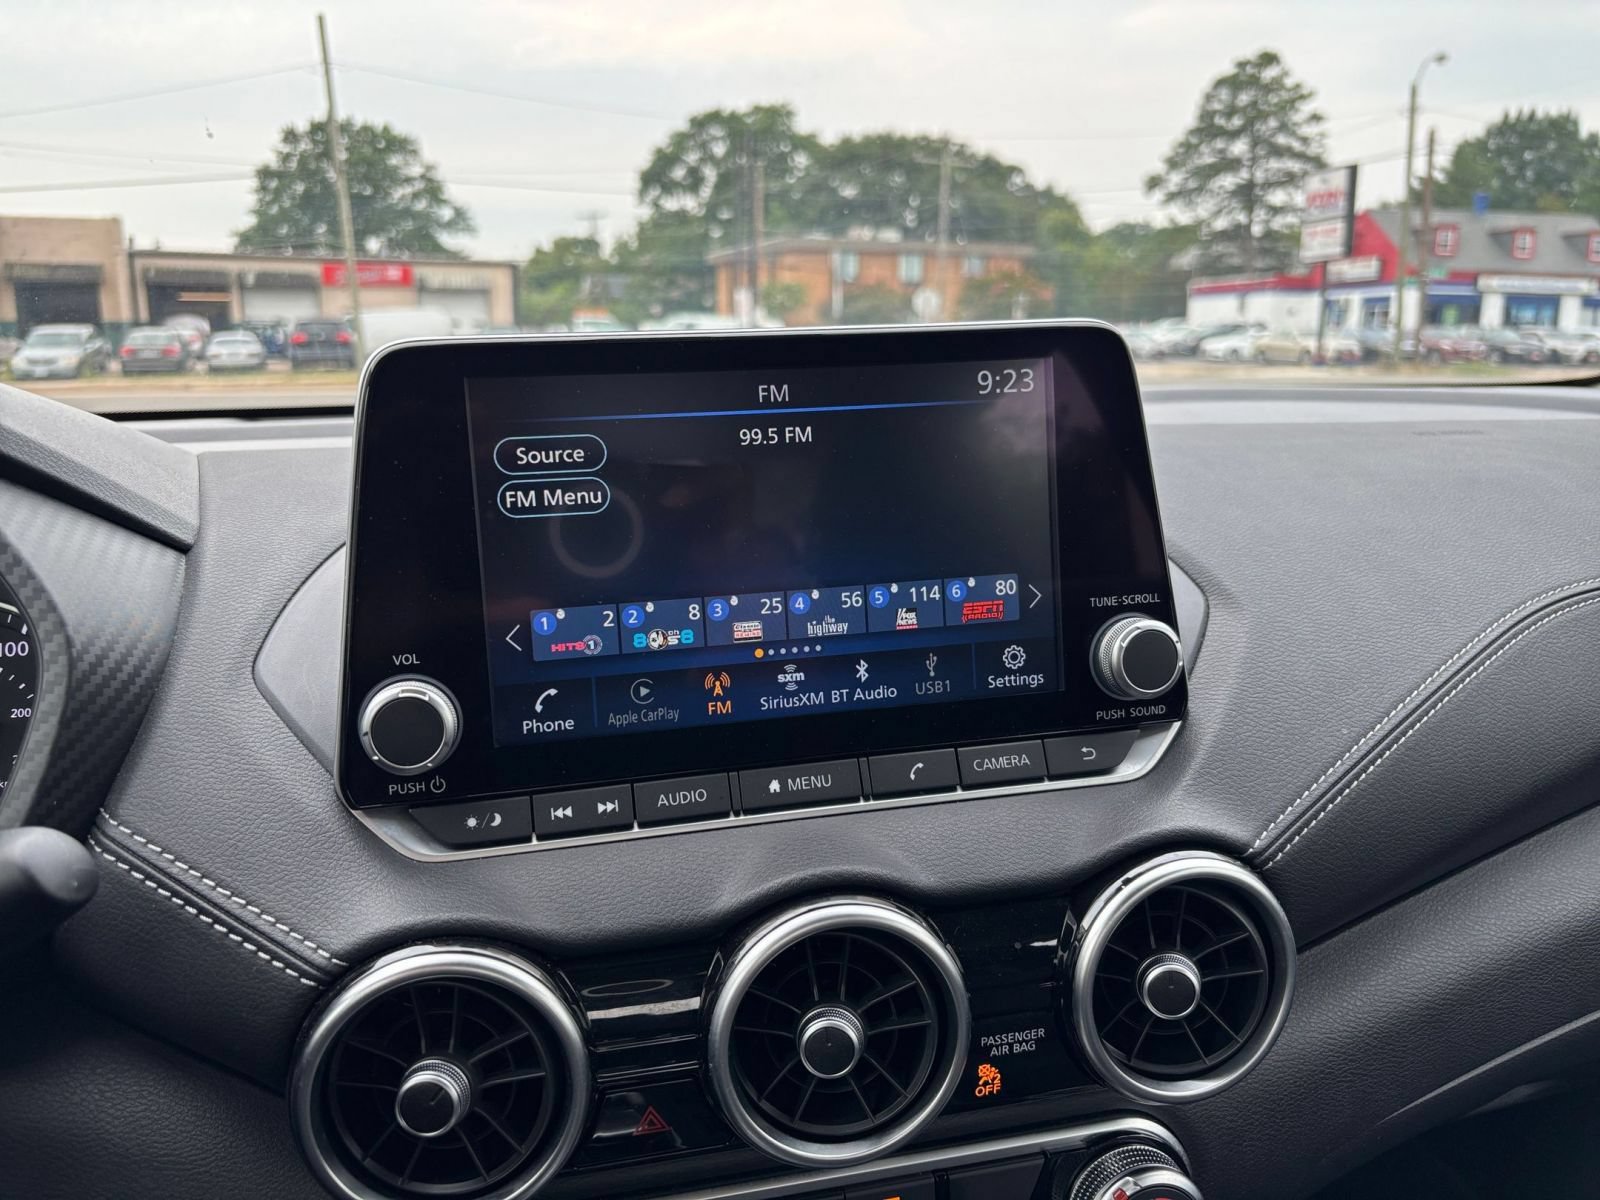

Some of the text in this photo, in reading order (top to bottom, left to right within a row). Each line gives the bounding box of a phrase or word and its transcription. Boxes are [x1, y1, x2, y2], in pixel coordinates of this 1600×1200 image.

[977, 368, 1035, 395] 9:23
[758, 384, 789, 403] FM
[739, 426, 812, 446] 99.5 FM
[515, 446, 585, 465] Source
[505, 488, 602, 508] FM Menu
[909, 585, 941, 603] 114
[952, 584, 961, 598] 6
[995, 579, 1017, 596] 80
[795, 597, 805, 610] 4
[841, 591, 863, 609] 56
[874, 590, 883, 604] 5
[688, 604, 700, 620] 8
[713, 603, 722, 617] 3
[760, 598, 783, 615] 25
[540, 617, 549, 631] 1
[602, 610, 615, 627] 2
[628, 610, 638, 624] 2
[807, 620, 849, 637] highway
[392, 653, 421, 666] VOL
[777, 671, 805, 683] sxm
[987, 672, 1044, 689] Settings
[831, 685, 898, 704] BT Audio
[915, 680, 950, 695] USB1
[708, 700, 732, 715] FM
[760, 691, 825, 710] SiriusXM
[10, 708, 32, 719] 200
[607, 707, 680, 728] Apple CarPlay
[1096, 705, 1166, 721] PUSH SOUND
[522, 718, 575, 735] Phone
[973, 754, 1031, 772] CAMERA
[388, 782, 426, 796] PUSH
[787, 774, 832, 792] MENU
[657, 788, 707, 808] AUDIO
[981, 1028, 1045, 1047] PASSENGER
[990, 1041, 1036, 1057] AIR BAG
[975, 1084, 1001, 1097] OFF
